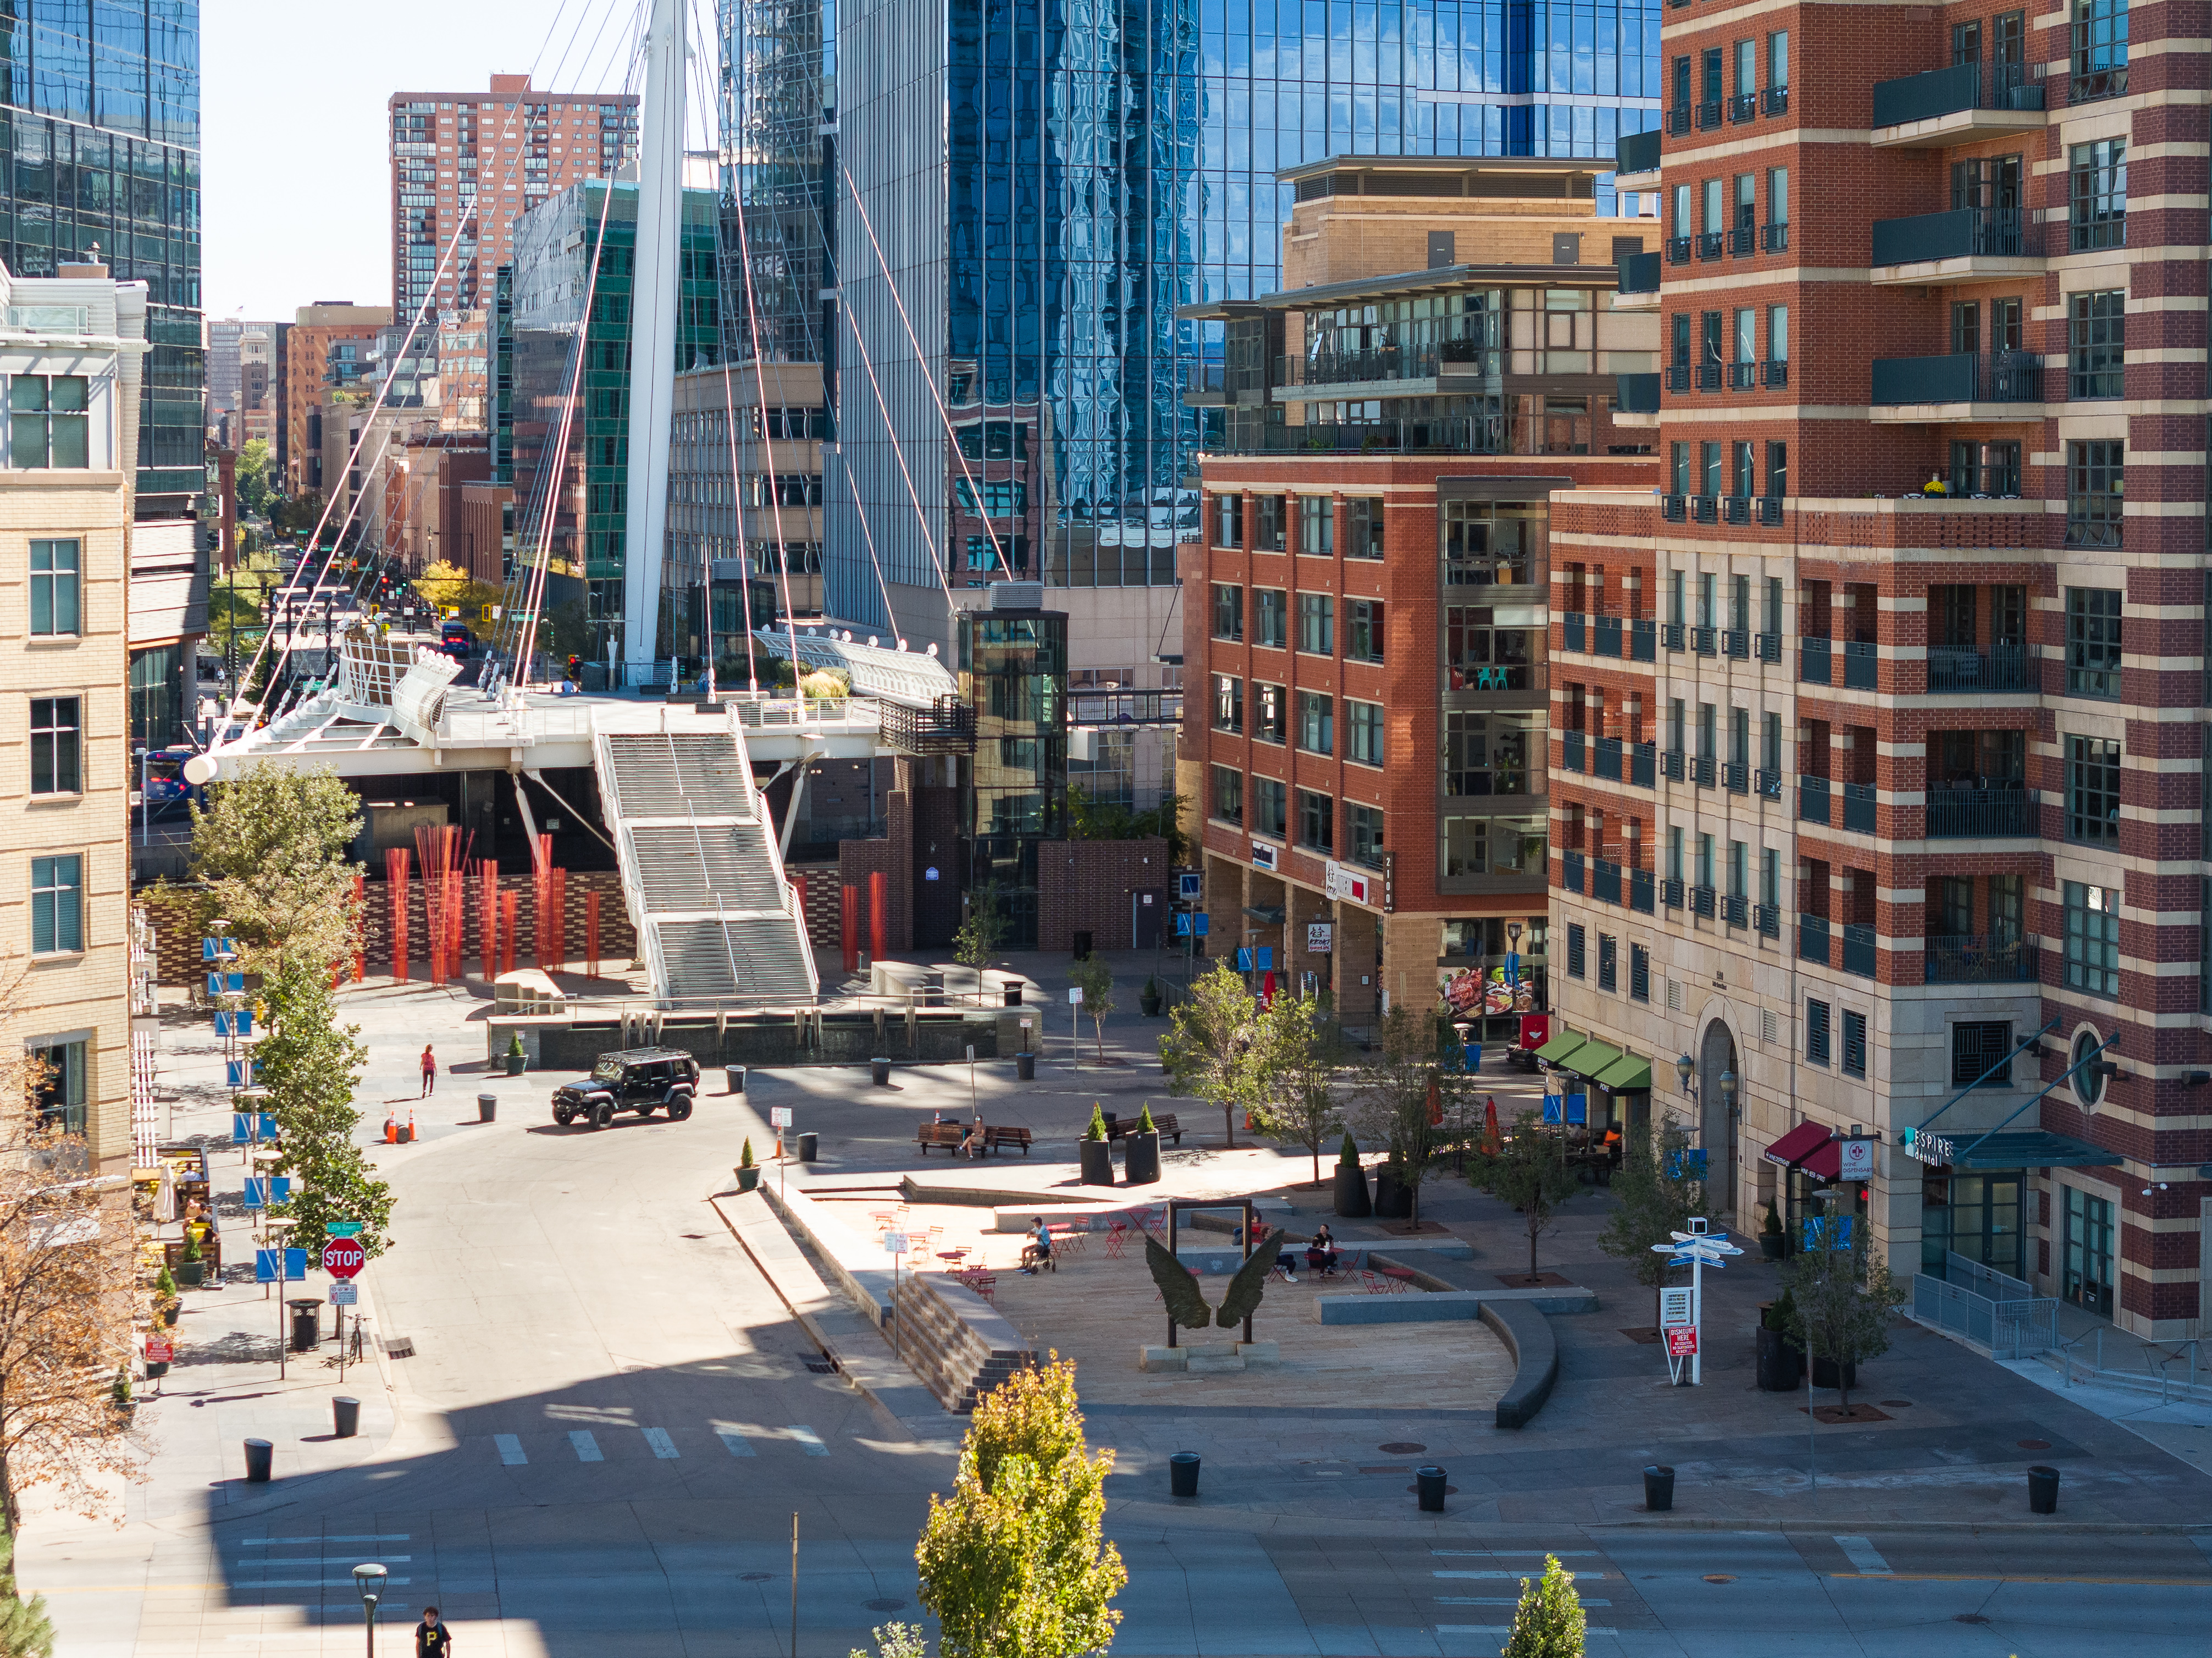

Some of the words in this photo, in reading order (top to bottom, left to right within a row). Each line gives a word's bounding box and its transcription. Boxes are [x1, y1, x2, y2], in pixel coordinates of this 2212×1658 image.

[1600, 1083, 1610, 1092] POKE
[1915, 1130, 1950, 1157] ESPIRE
[1915, 1147, 1938, 1167] dental
[325, 1250, 363, 1267] STOP
[331, 1292, 338, 1302] NO
[1671, 1327, 1695, 1336] DISMOUNT
[427, 1631, 437, 1646] P
